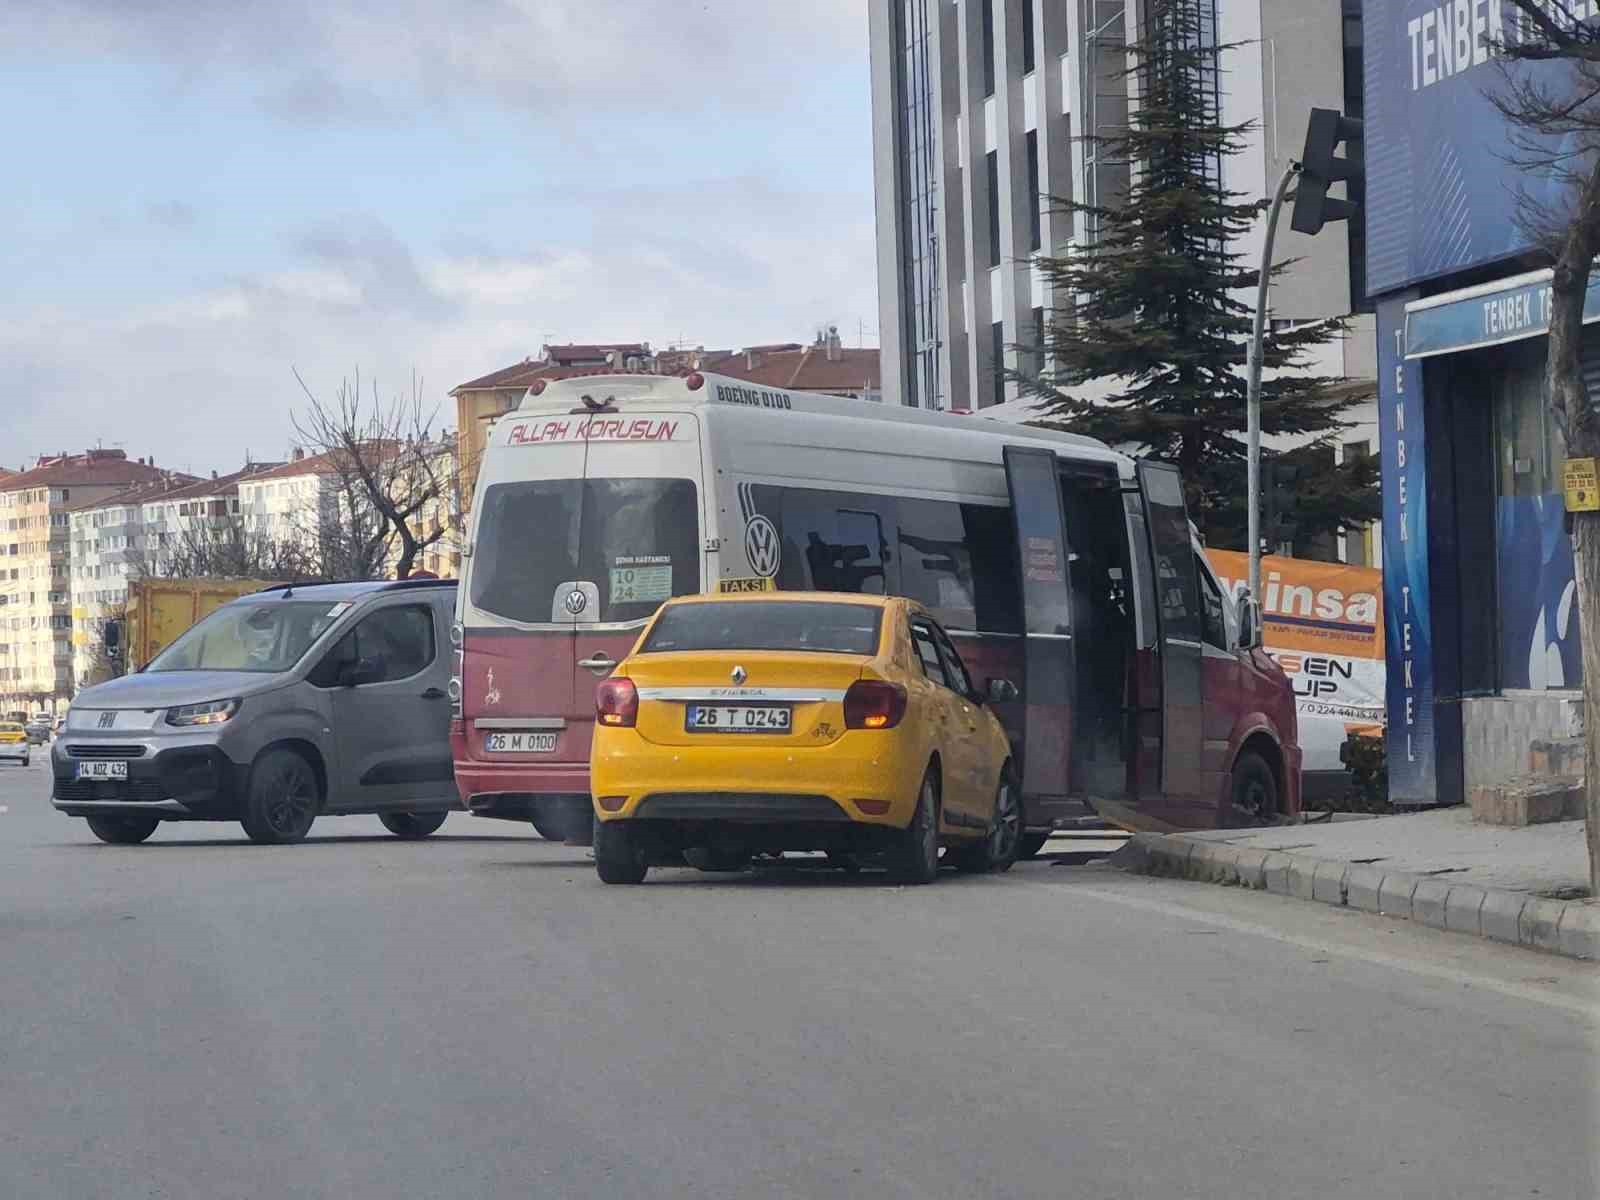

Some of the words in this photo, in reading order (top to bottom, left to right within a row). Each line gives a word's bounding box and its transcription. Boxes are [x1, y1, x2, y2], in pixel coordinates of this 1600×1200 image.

[1484, 293, 1531, 334] TENBEK
[508, 421, 570, 445] ALLAH
[575, 420, 678, 441] KORUSUN
[1395, 329, 1408, 542] TENBEK
[1402, 586, 1414, 762] TEKEL
[616, 569, 634, 585] 10
[697, 709, 717, 725] 26
[728, 710, 738, 725] T
[746, 711, 788, 726] 0243
[492, 735, 506, 749] 26
[512, 735, 521, 749] M
[528, 735, 555, 750] 0100
[80, 763, 89, 775] 14
[111, 763, 126, 775] 432
